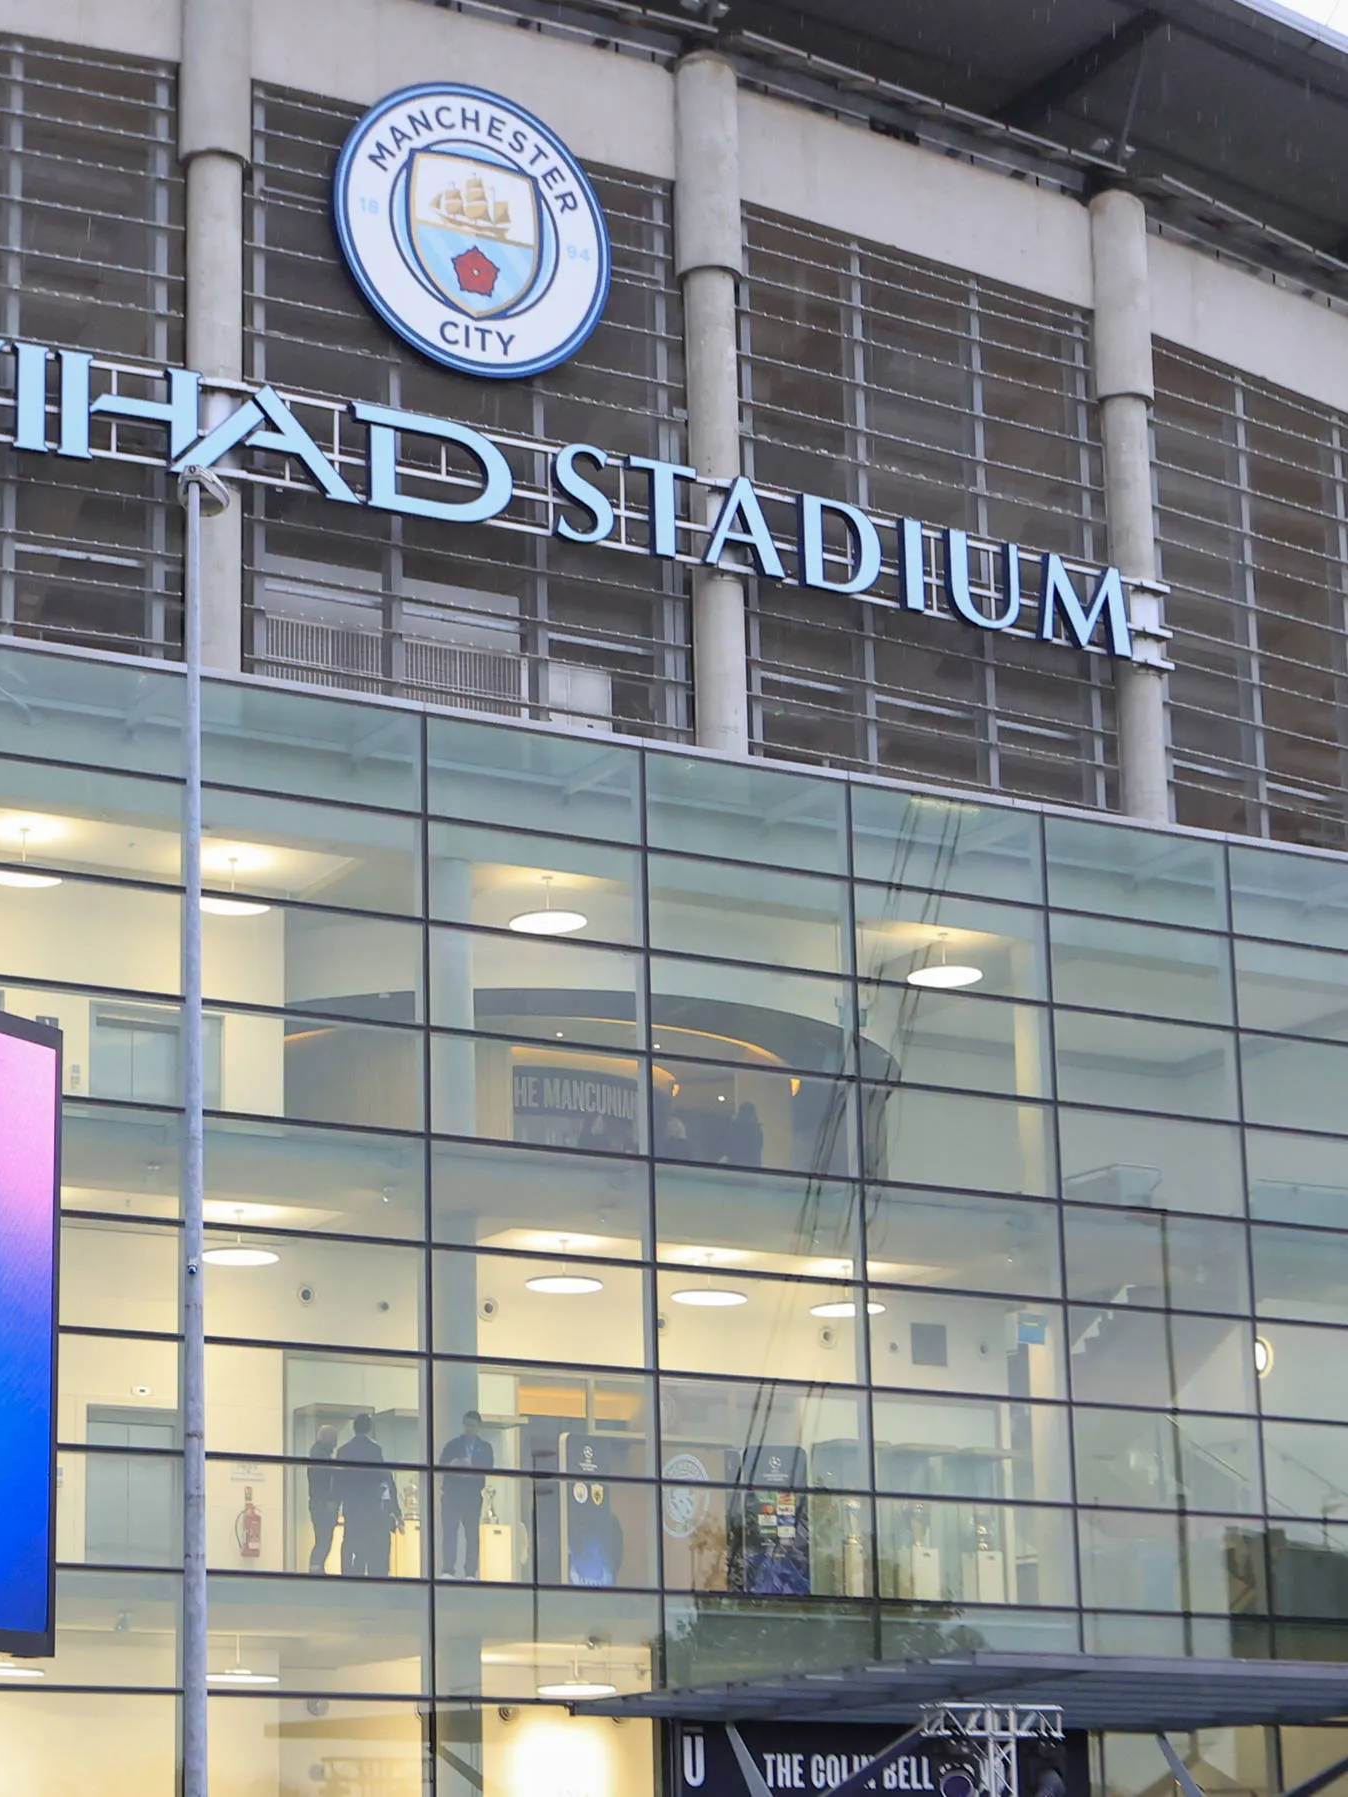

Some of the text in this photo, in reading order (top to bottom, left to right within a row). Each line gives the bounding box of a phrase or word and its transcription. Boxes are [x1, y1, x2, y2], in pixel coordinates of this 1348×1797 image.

[366, 105, 579, 216] MANCHESTER
[358, 196, 379, 215] 18
[565, 244, 591, 264] 94
[438, 320, 516, 357] CITY
[552, 442, 1134, 659] STADIUM
[762, 1752, 805, 1788] THE
[883, 1754, 935, 1791] BELL
